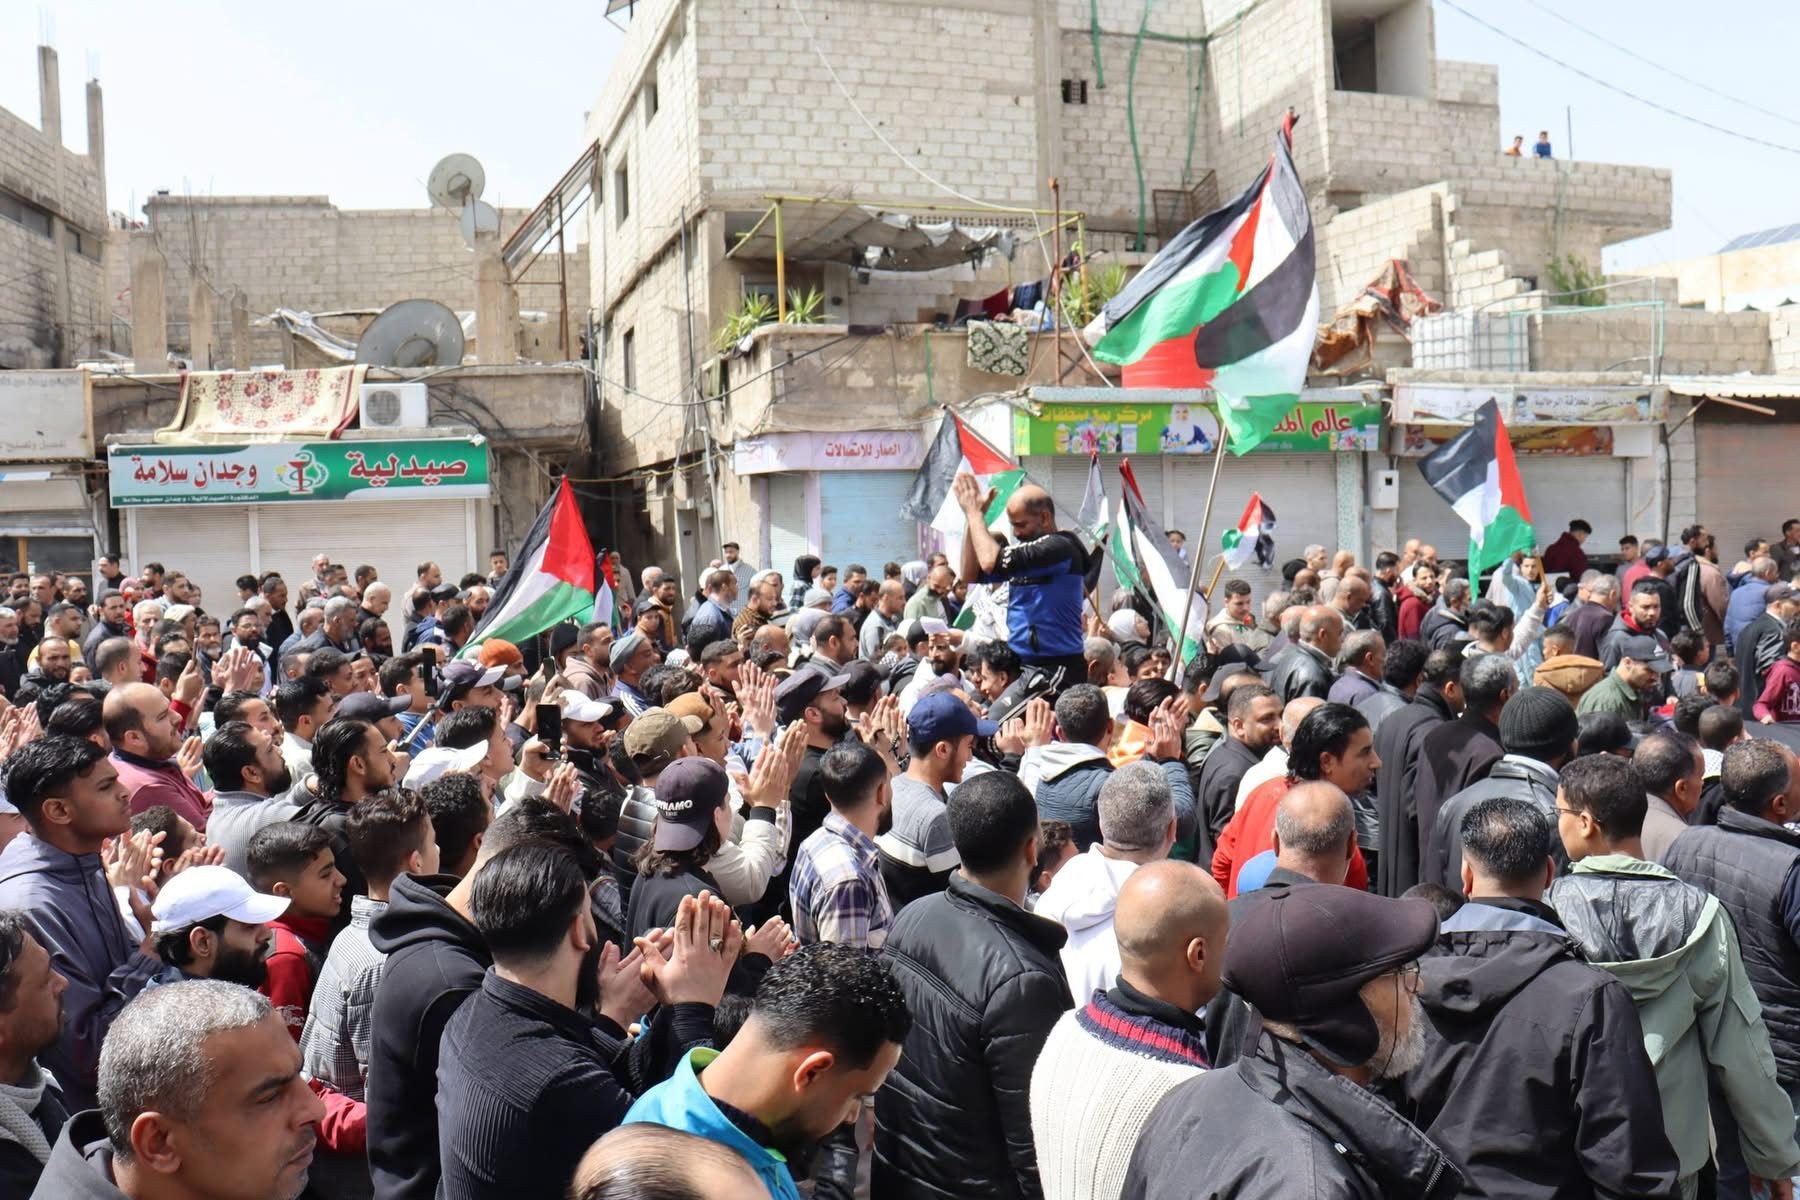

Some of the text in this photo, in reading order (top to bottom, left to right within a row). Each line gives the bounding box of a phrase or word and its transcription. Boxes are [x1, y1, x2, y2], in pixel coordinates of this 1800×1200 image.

[1115, 403, 1153, 425] مركز
[1310, 406, 1353, 439] عالم
[824, 441, 873, 458] للاتصالات
[131, 449, 468, 489] صيدلية وجدان سلامة
